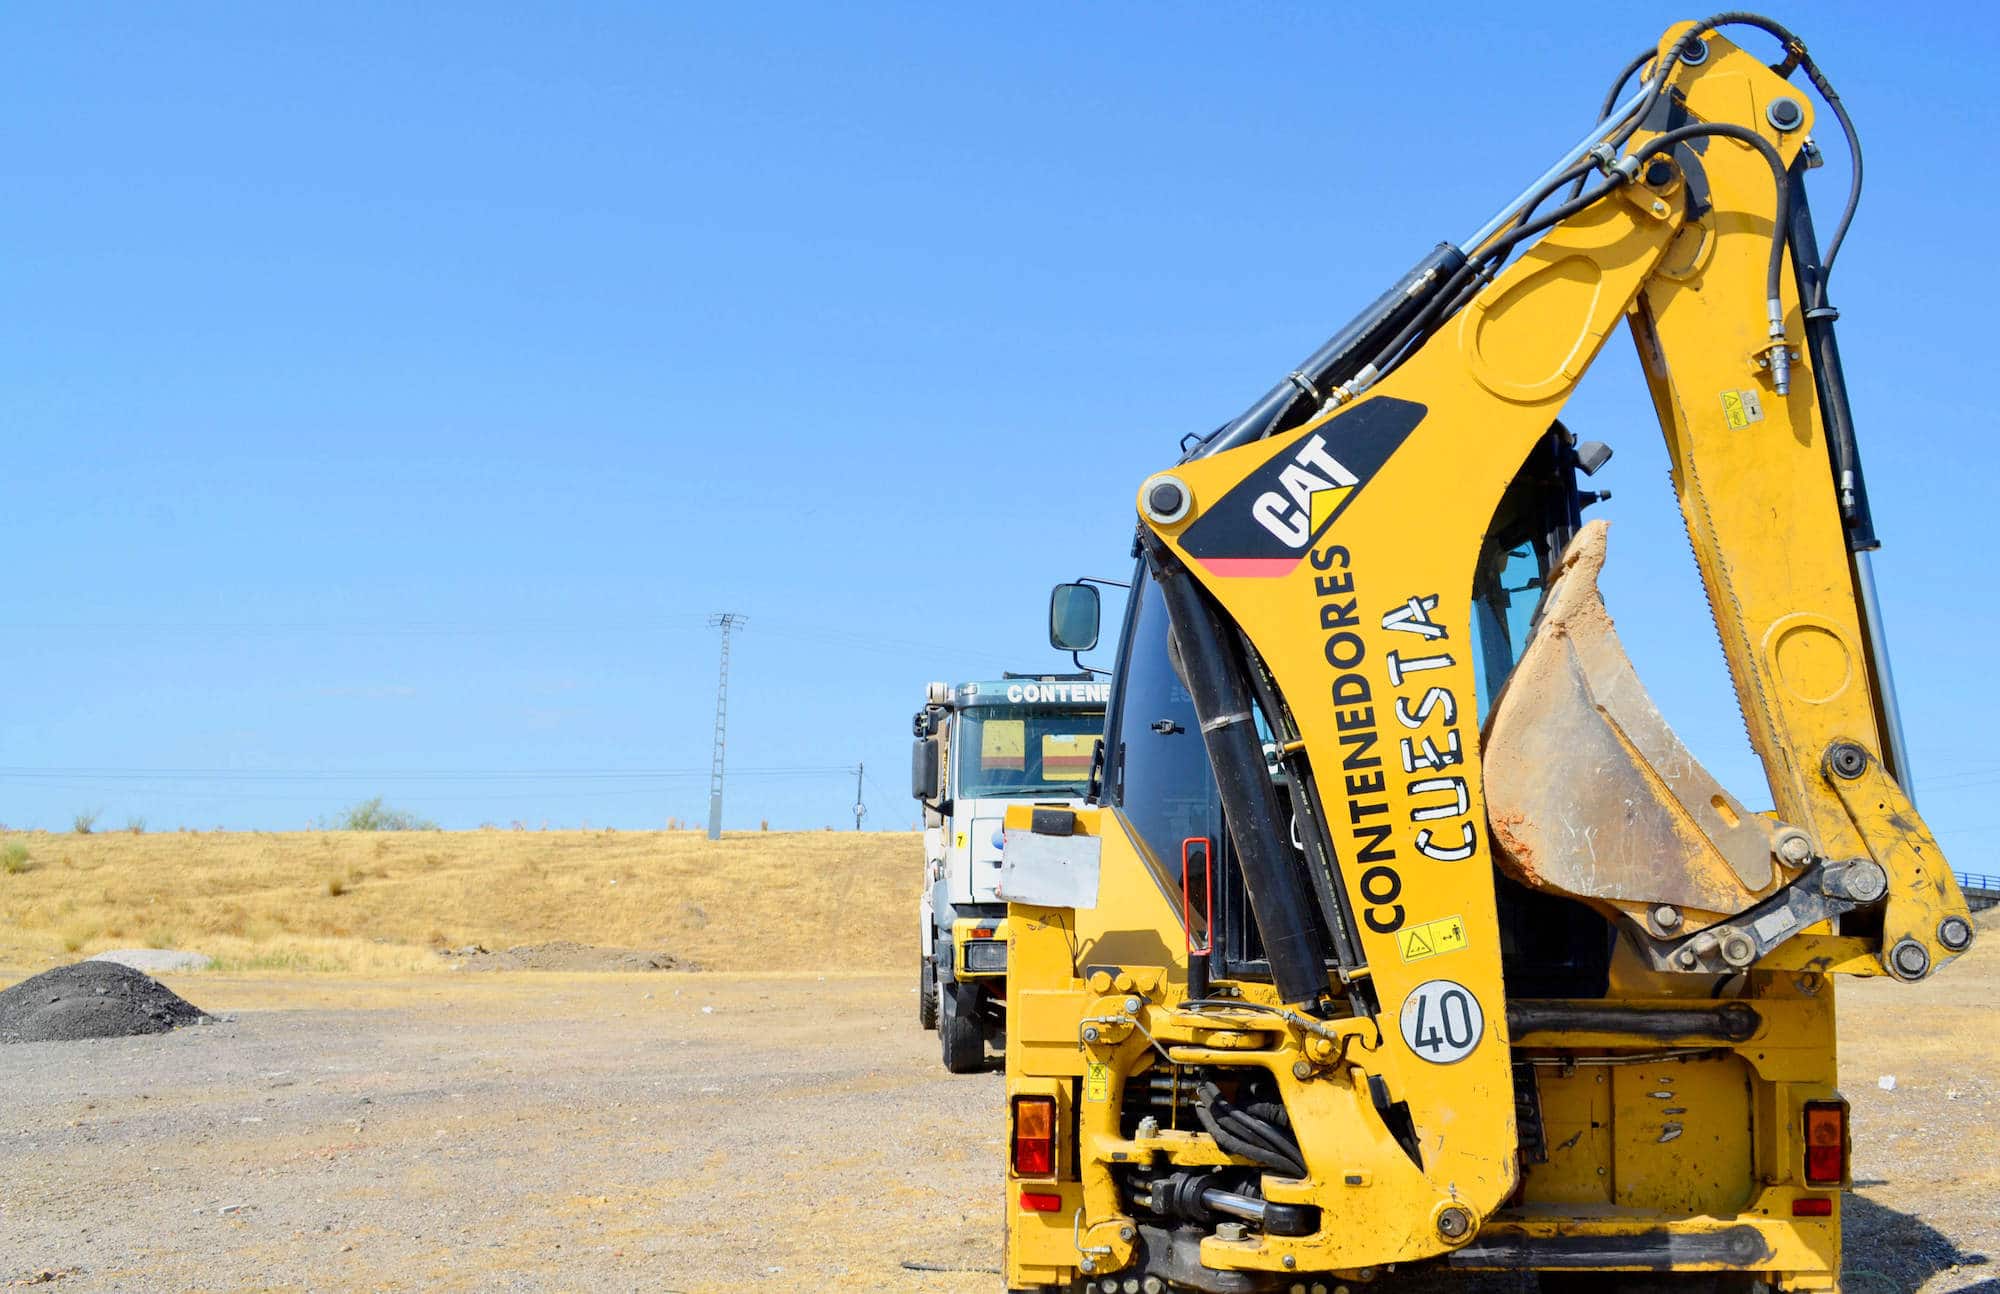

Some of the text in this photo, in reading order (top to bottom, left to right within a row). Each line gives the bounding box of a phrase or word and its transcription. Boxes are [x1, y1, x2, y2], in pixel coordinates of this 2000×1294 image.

[1252, 434, 1360, 549] CAT
[1310, 544, 1406, 934] CONTENEDORES
[1381, 593, 1477, 861] CUESTA
[1415, 989, 1473, 1053] 40
